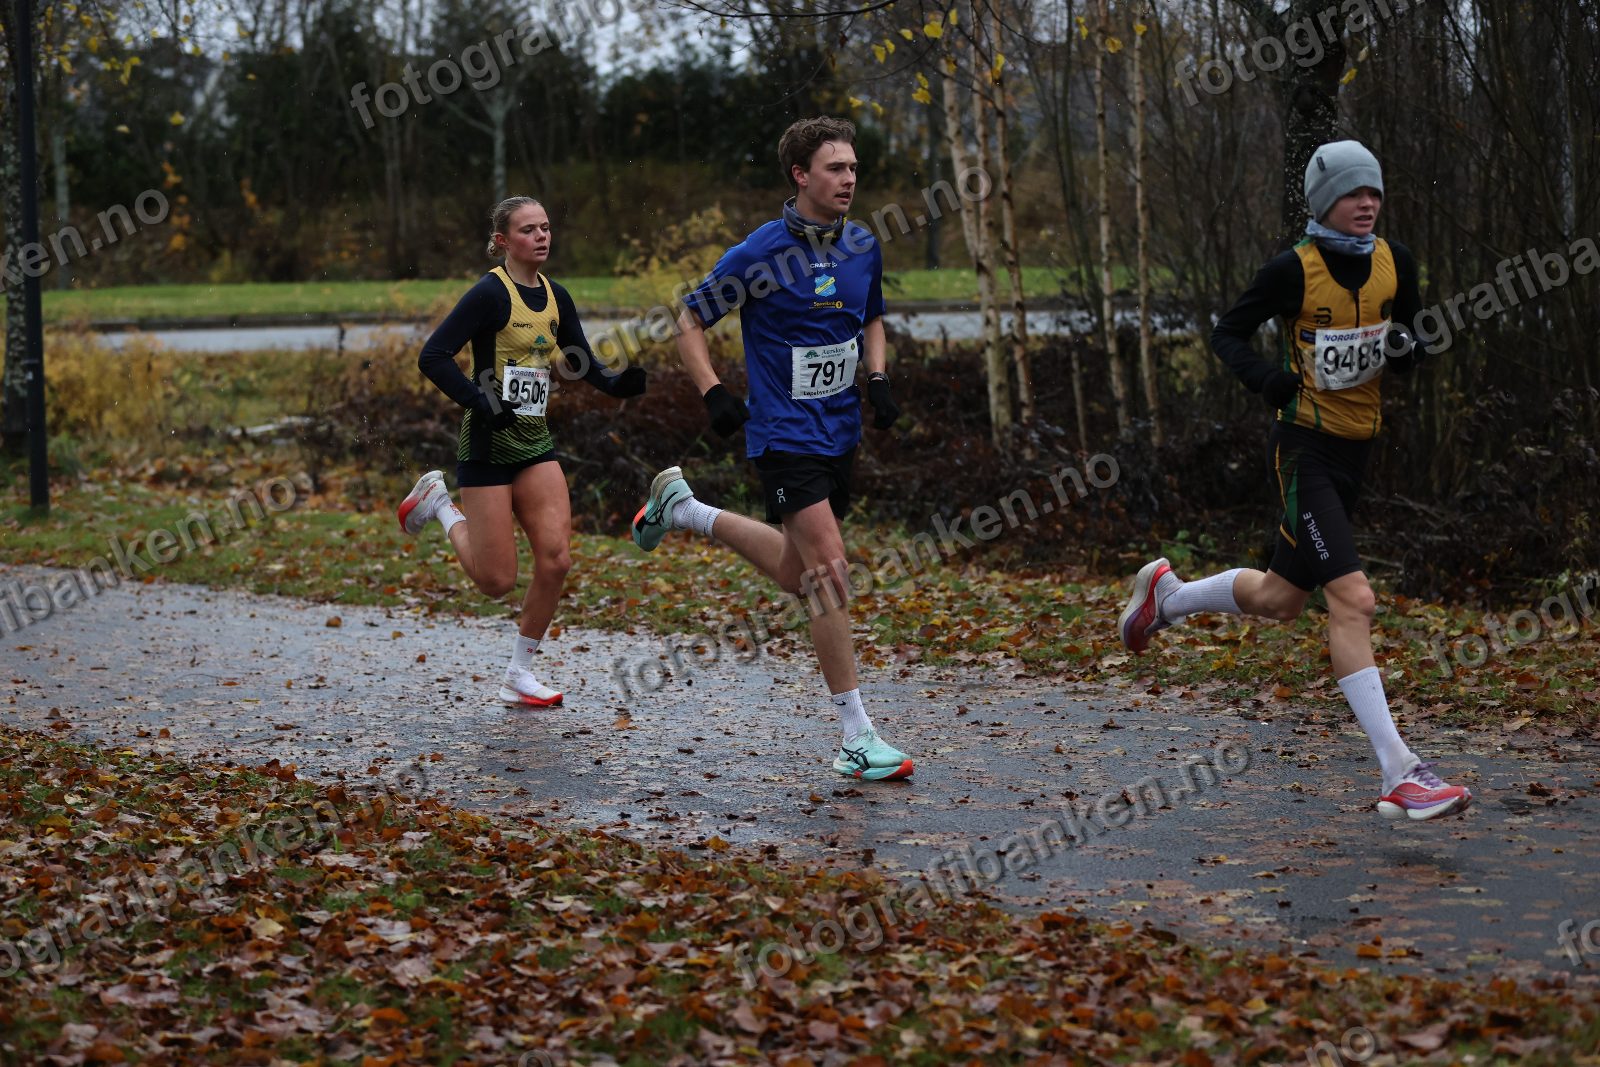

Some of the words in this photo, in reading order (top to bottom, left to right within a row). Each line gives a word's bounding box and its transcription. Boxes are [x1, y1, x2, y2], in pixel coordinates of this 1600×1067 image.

[807, 358, 846, 388] 791
[1323, 340, 1382, 376] 9485
[508, 378, 547, 405] 9506
